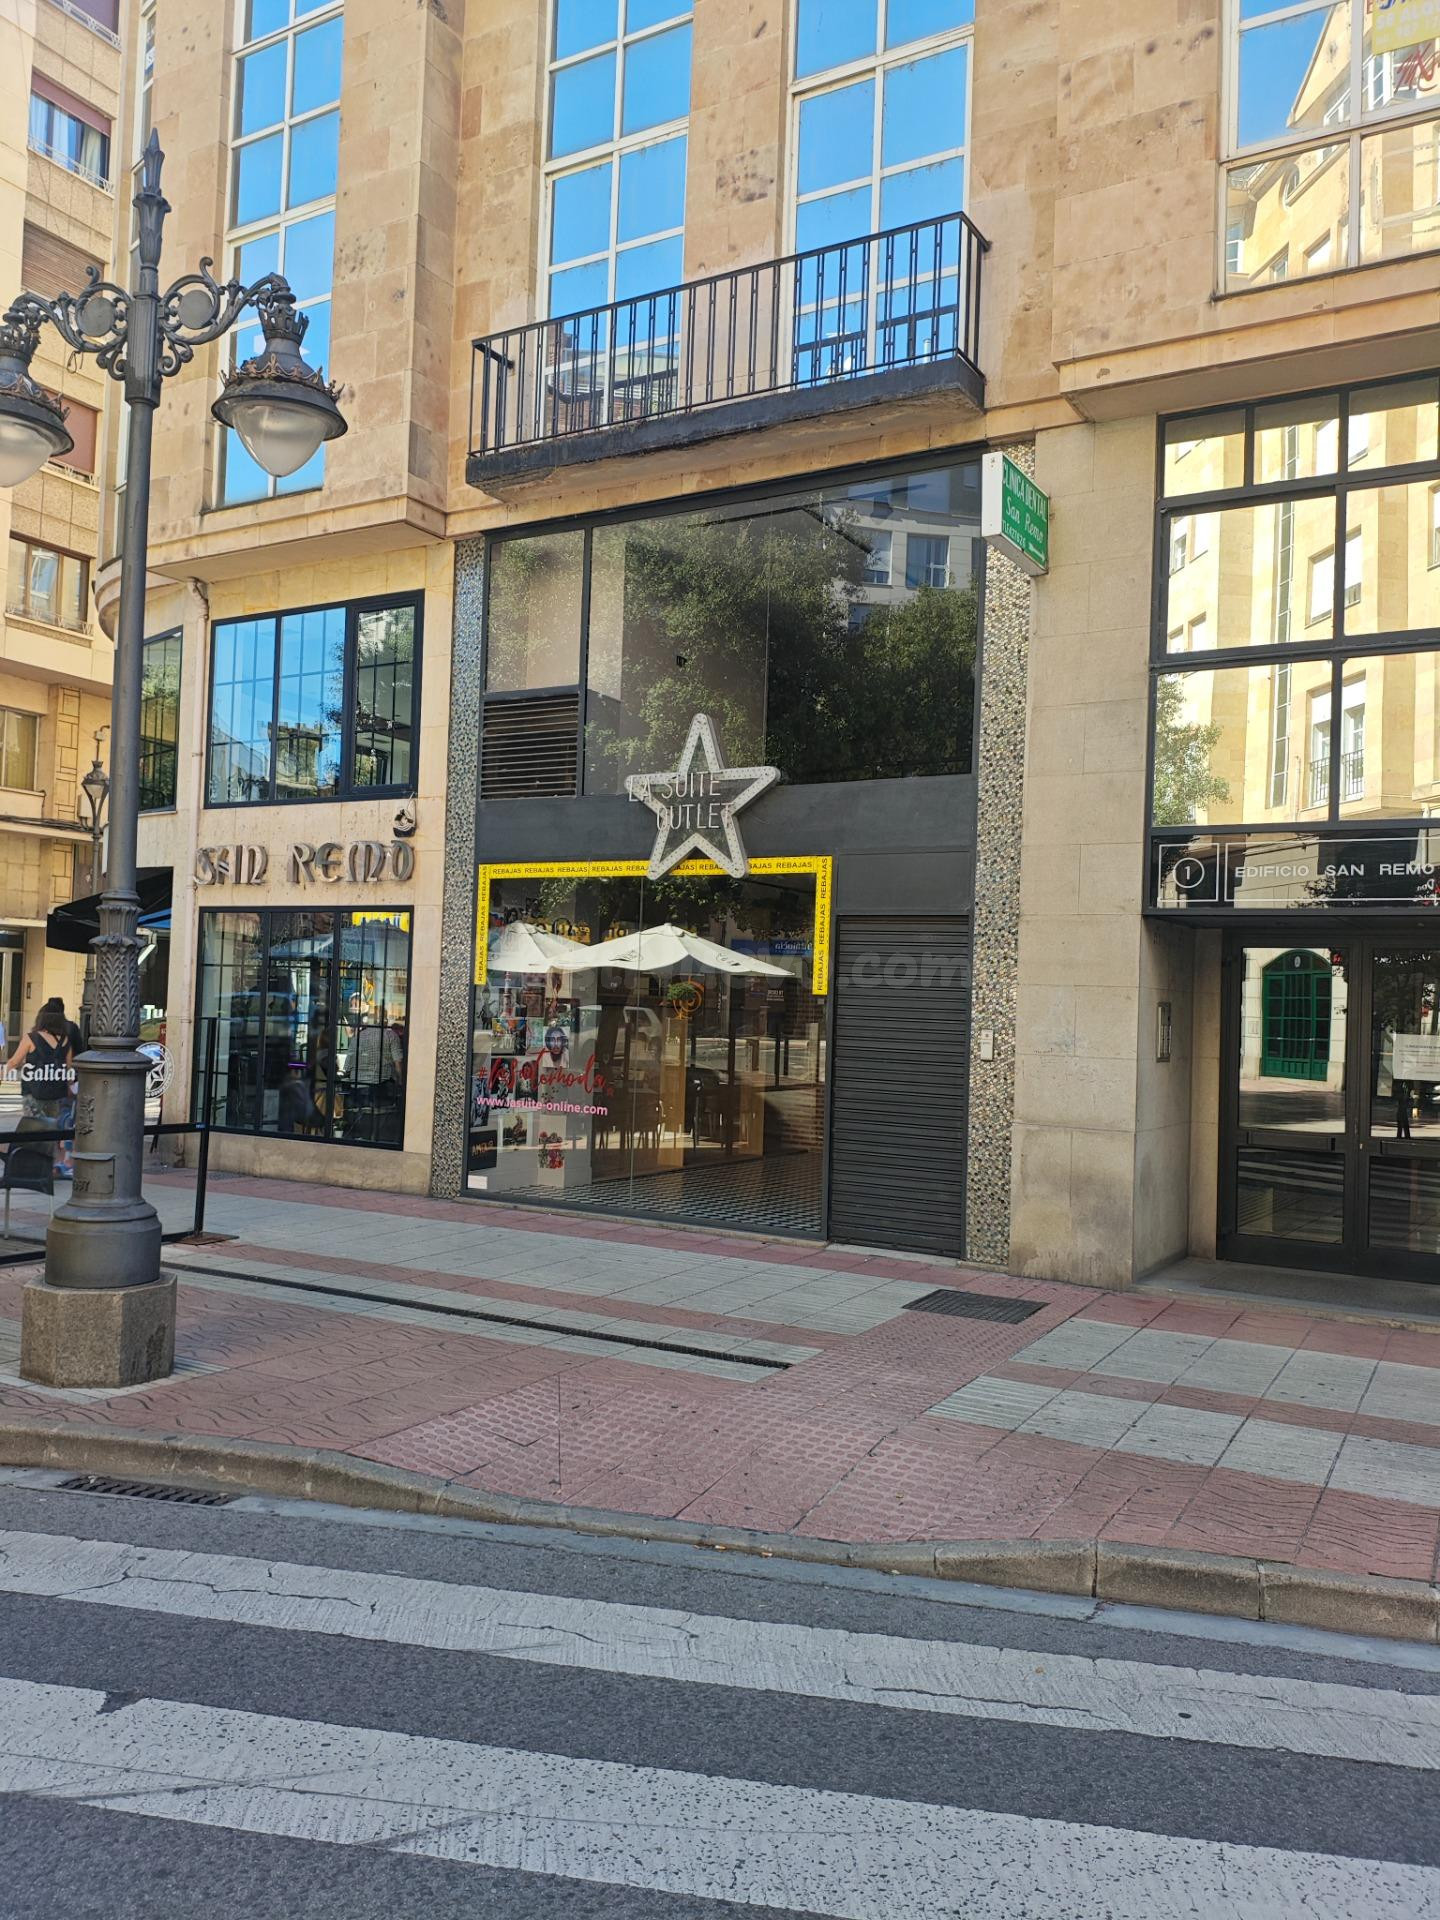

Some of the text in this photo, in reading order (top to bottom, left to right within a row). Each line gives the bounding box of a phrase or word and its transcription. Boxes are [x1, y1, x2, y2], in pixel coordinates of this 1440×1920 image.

[1006, 496, 1044, 544] San Remo
[1025, 483, 1047, 522] DENTAL
[628, 771, 724, 803] LA SUITE
[656, 802, 735, 830] OUTLET
[193, 840, 415, 886] SAN REMO
[820, 857, 828, 899] REBAJAS
[1235, 863, 1435, 878] EDIFICIO SAN REMO
[816, 949, 825, 991] REBAJAS
[21, 1062, 76, 1082] Galicia
[476, 1096, 609, 1116] www.lasuite-online.com
